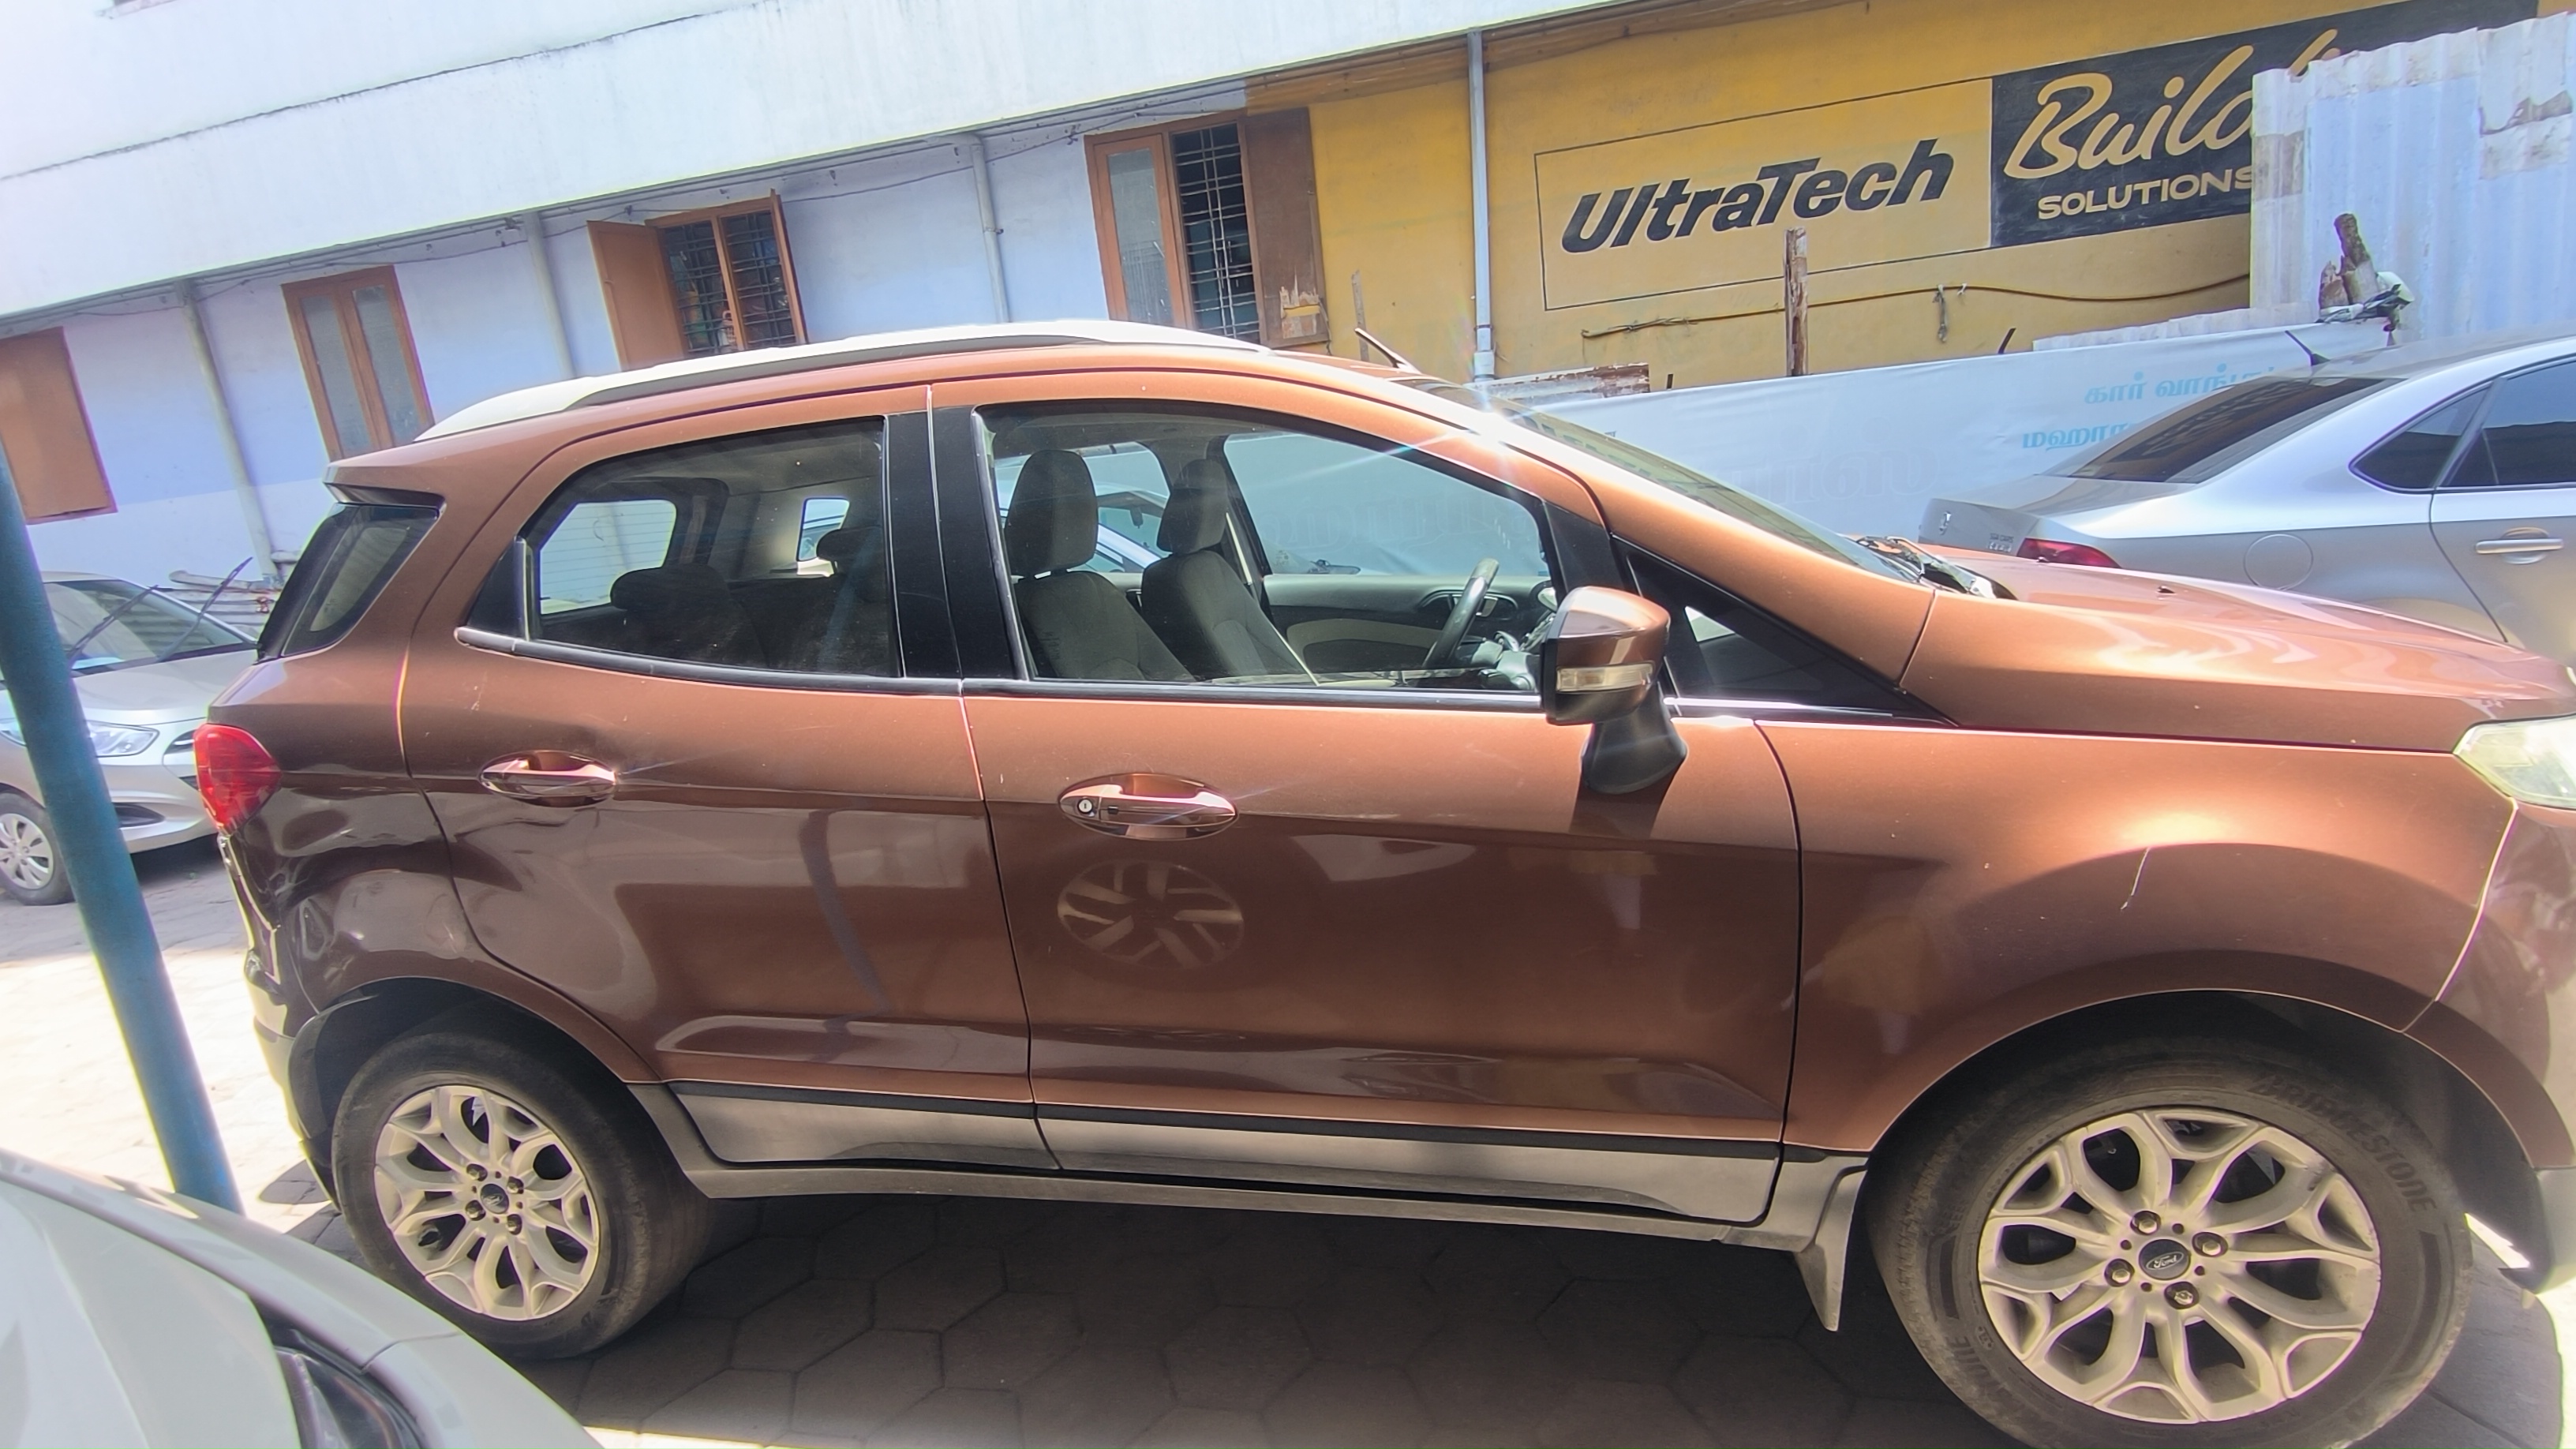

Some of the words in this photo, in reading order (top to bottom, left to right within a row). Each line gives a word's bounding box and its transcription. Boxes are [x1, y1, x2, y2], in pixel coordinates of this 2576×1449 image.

[1561, 138, 1954, 253] UltraTech
[2038, 168, 2253, 220] SOLUTIONS
[2084, 371, 2147, 404] கார்
